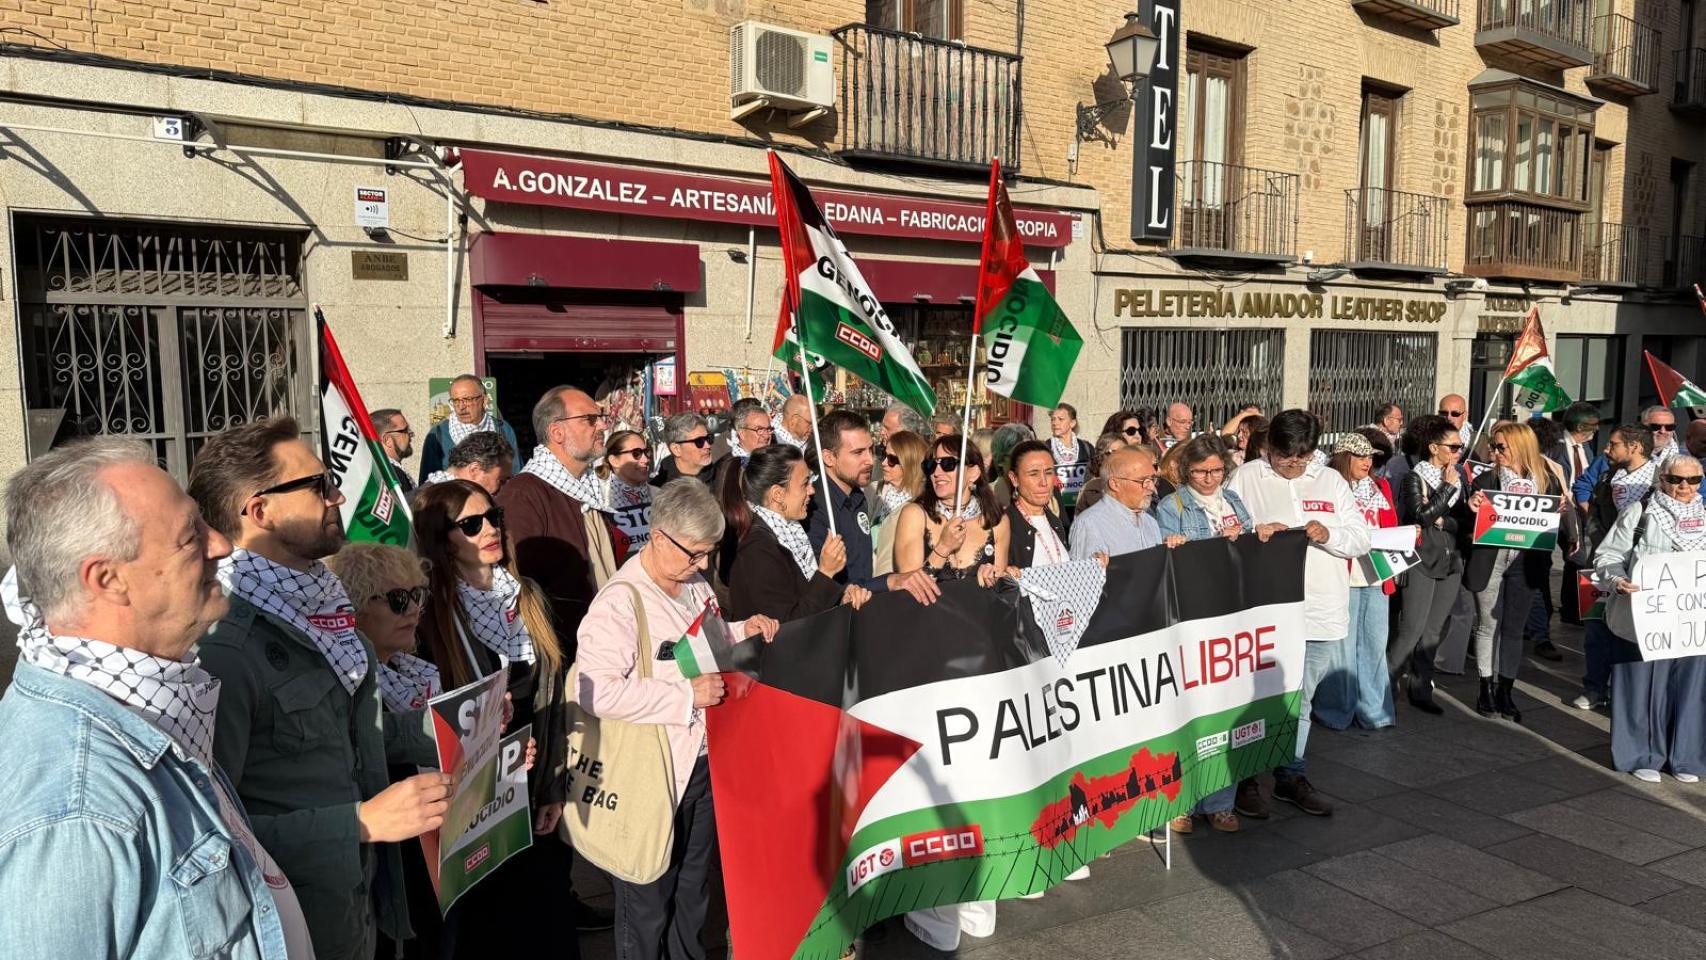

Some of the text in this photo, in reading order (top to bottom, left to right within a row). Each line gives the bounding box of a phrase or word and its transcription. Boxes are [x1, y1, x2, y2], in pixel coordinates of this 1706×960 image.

[493, 168, 648, 204] A.GONZALEZ
[670, 187, 778, 216] ARTESANÍ
[824, 202, 884, 225] EDANA
[1016, 220, 1057, 237] ROPIA
[1114, 286, 1447, 323] PELETERÍA AMADOR LEATHER SHOP
[837, 325, 883, 361] CCOO
[1303, 500, 1325, 511] UGT
[1493, 494, 1554, 514] STOP
[1489, 514, 1549, 528] GENOCIDIO
[1641, 562, 1678, 591] LA
[1645, 594, 1667, 614] SE
[1644, 631, 1672, 651] CON
[936, 625, 1277, 766] PALESTINA LIBRE
[1235, 724, 1252, 740] UGT
[581, 784, 618, 811] BAG
[466, 847, 489, 870] CCOO
[850, 831, 976, 887] UGT CCOO
